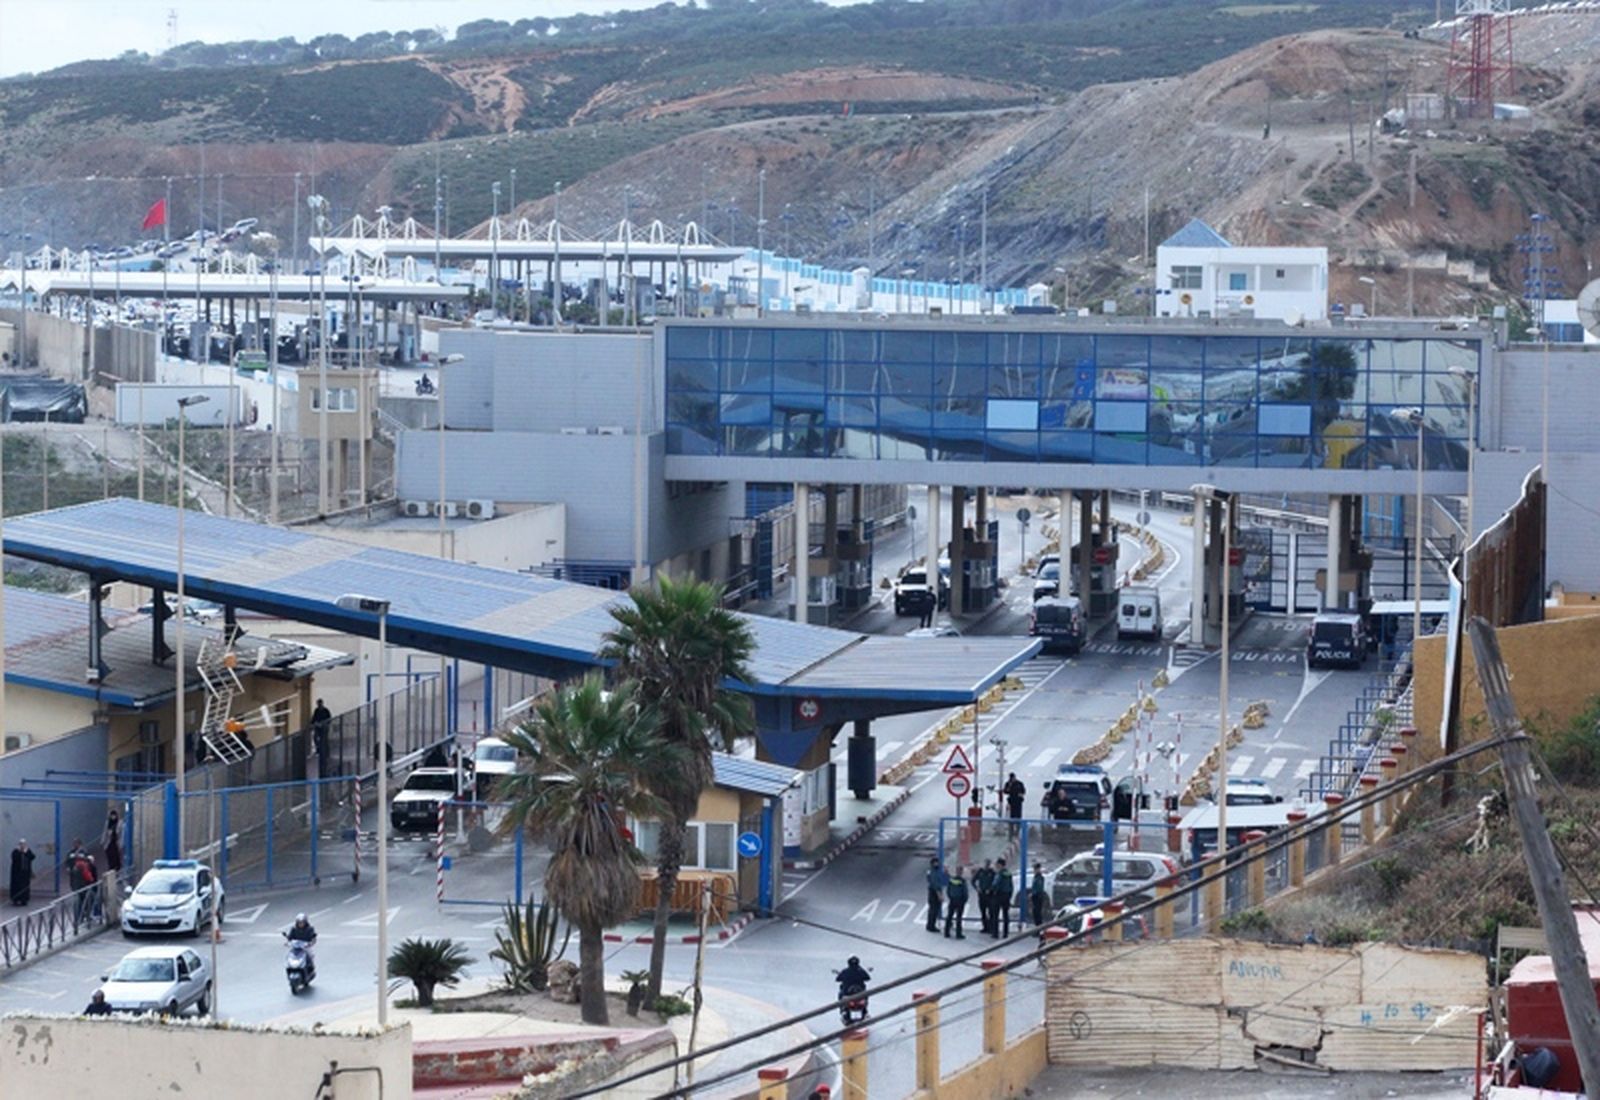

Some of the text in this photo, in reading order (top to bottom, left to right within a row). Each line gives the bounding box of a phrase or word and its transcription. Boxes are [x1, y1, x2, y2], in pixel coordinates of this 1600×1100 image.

[1223, 652, 1297, 663] DUANA
[1315, 650, 1351, 659] POLICIA
[876, 830, 943, 842] STO
